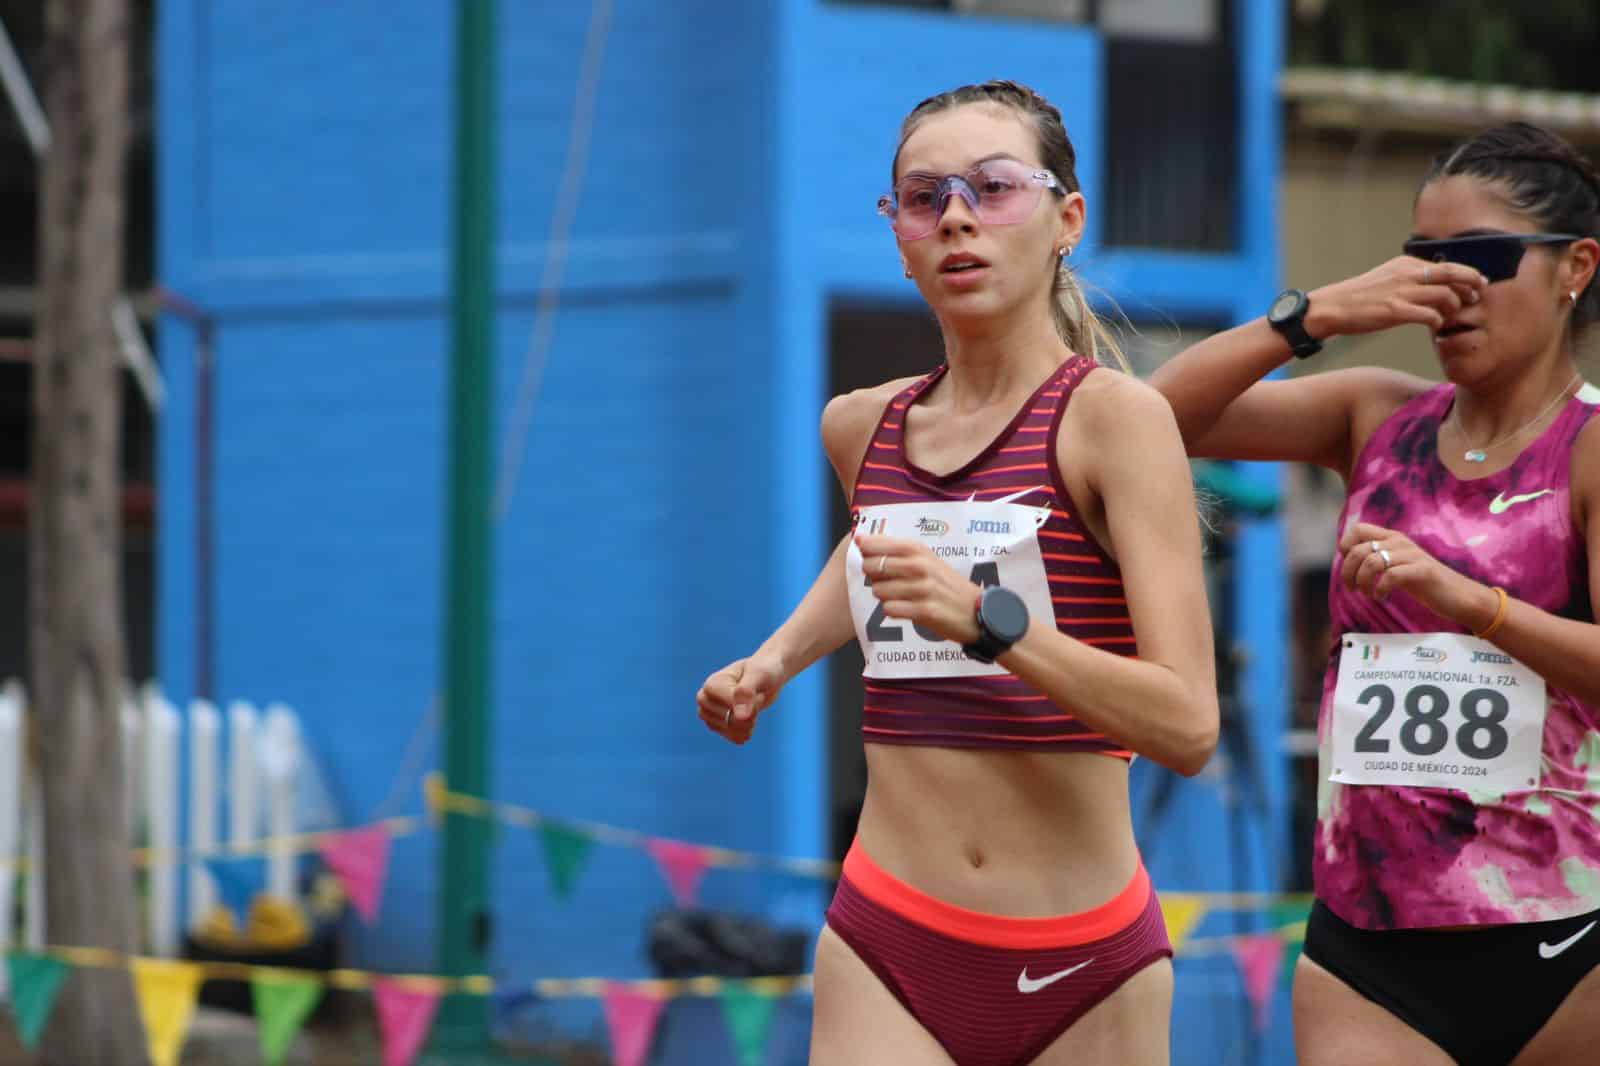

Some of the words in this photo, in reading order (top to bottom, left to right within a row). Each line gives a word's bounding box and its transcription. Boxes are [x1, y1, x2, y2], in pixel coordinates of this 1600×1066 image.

[931, 545, 968, 556] CIONAL
[877, 651, 916, 663] CIUDAD
[918, 651, 933, 661] DE
[935, 648, 969, 661] MÉXIC
[1354, 670, 1416, 681] CAMPEONATO
[1417, 670, 1474, 683] NACIONAL
[1497, 675, 1520, 687] FZA.
[1354, 683, 1510, 761] 288
[1364, 761, 1398, 771] CIUDAD
[1401, 762, 1415, 772] DE
[1416, 760, 1459, 775] MÉXICO
[1461, 765, 1488, 776] 2024
